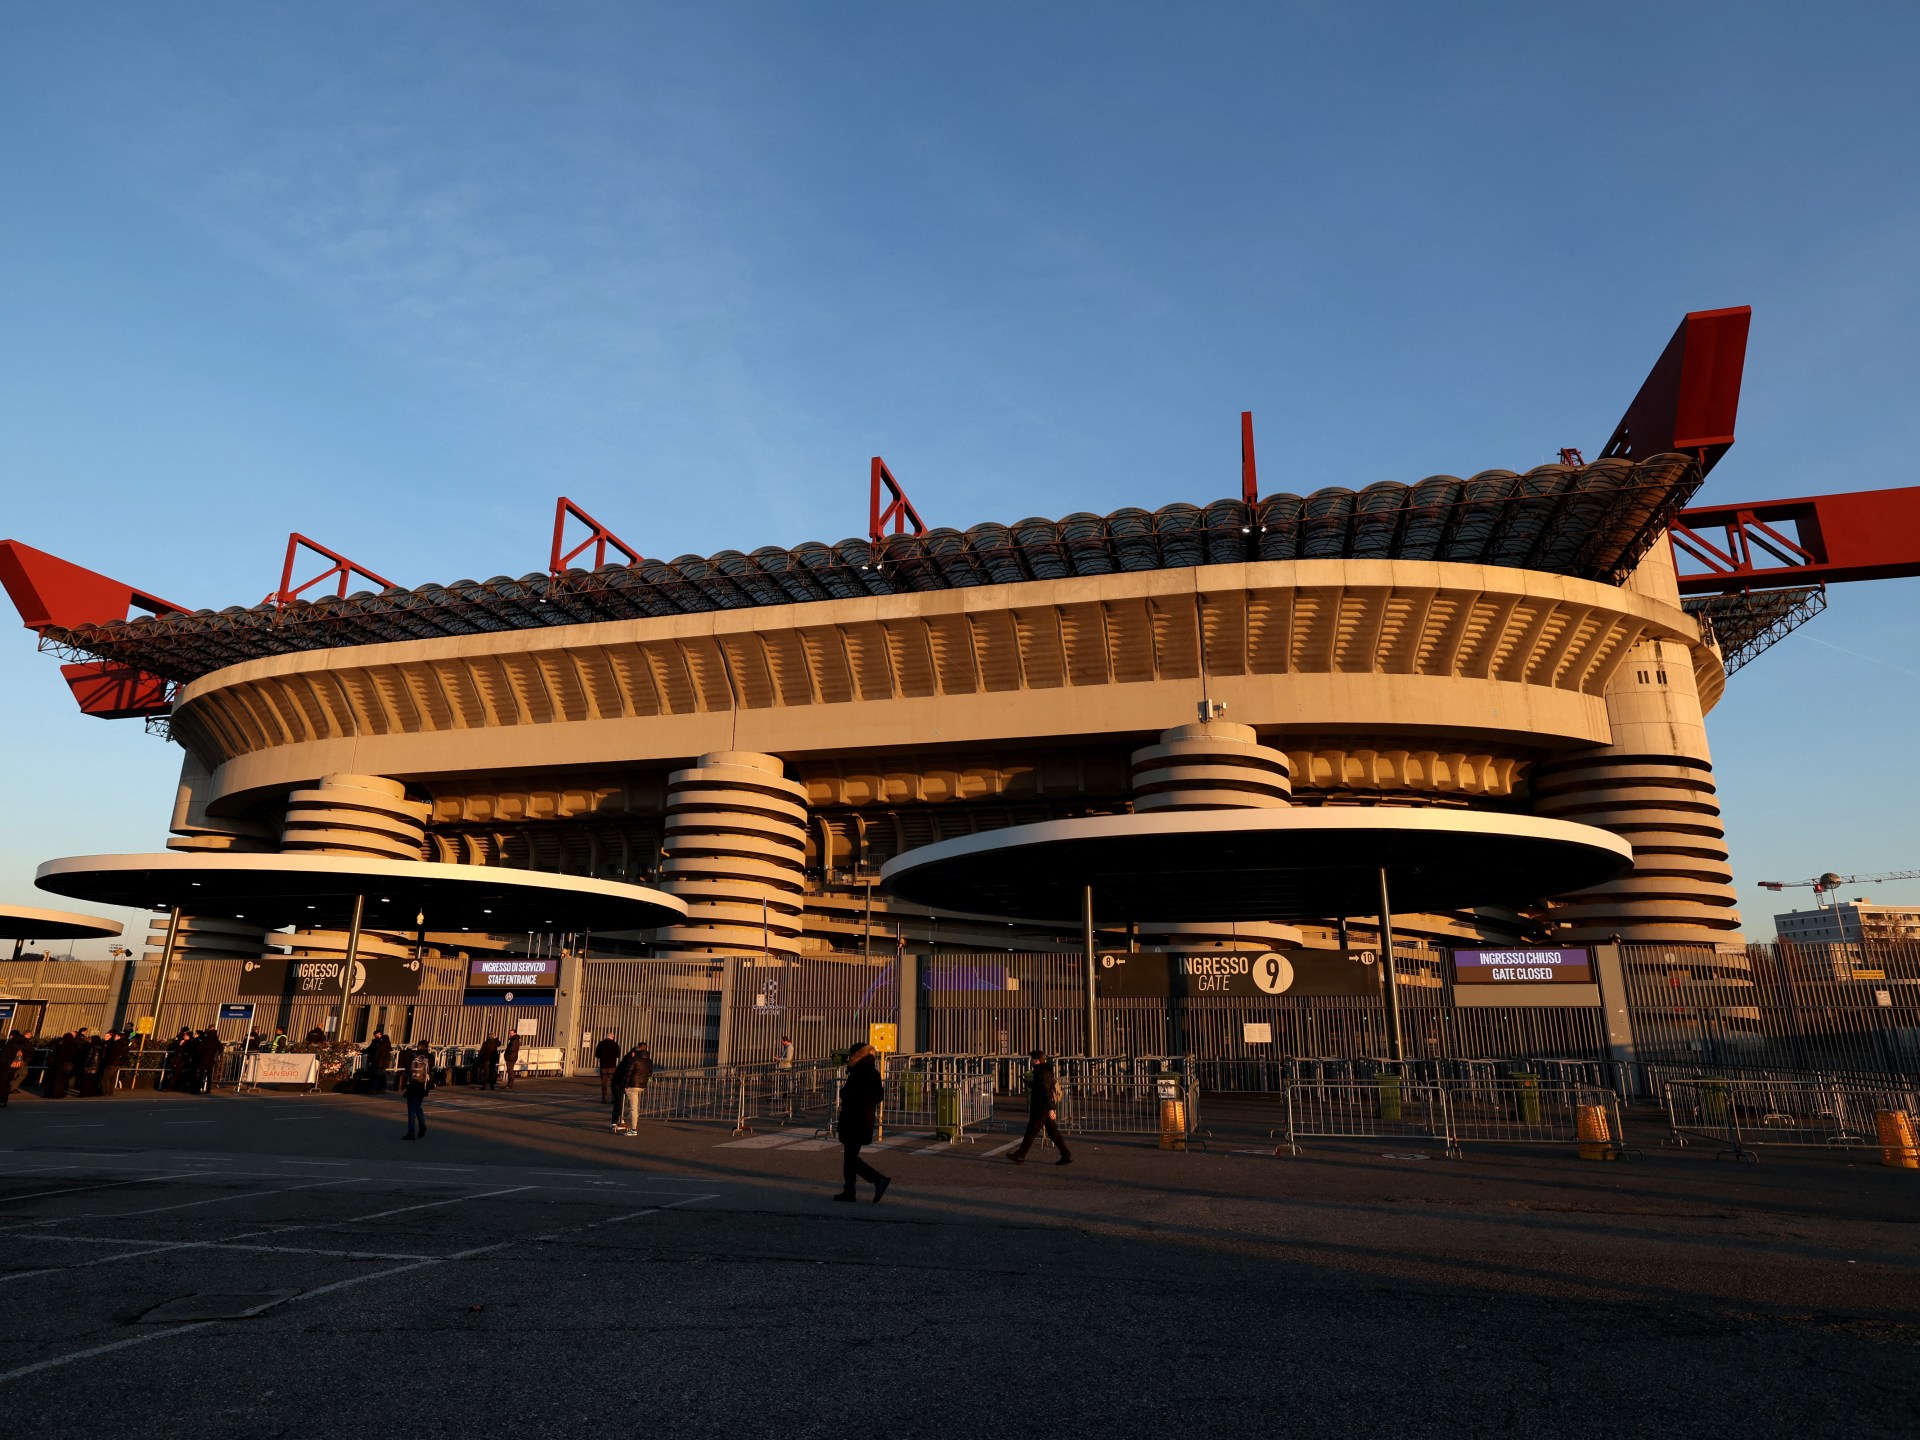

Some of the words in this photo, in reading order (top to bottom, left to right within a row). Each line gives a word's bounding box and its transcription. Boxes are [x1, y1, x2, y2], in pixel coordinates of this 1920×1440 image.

[1480, 953, 1525, 964] INGRESSO
[1526, 952, 1561, 963] CHIUSO
[292, 963, 338, 977] INGRESSO
[482, 963, 511, 972] INGRESSO
[511, 963, 518, 972] DI
[518, 962, 546, 971] SERVIZIO
[1178, 957, 1248, 975] INGRESSO
[1266, 958, 1280, 989] 9
[1492, 968, 1517, 979] GATE
[1517, 967, 1552, 979] CLOSED
[302, 978, 325, 990] GATE
[487, 975, 506, 985] STAFF
[506, 975, 537, 984] ENTRANCE
[1198, 975, 1230, 991] GATE
